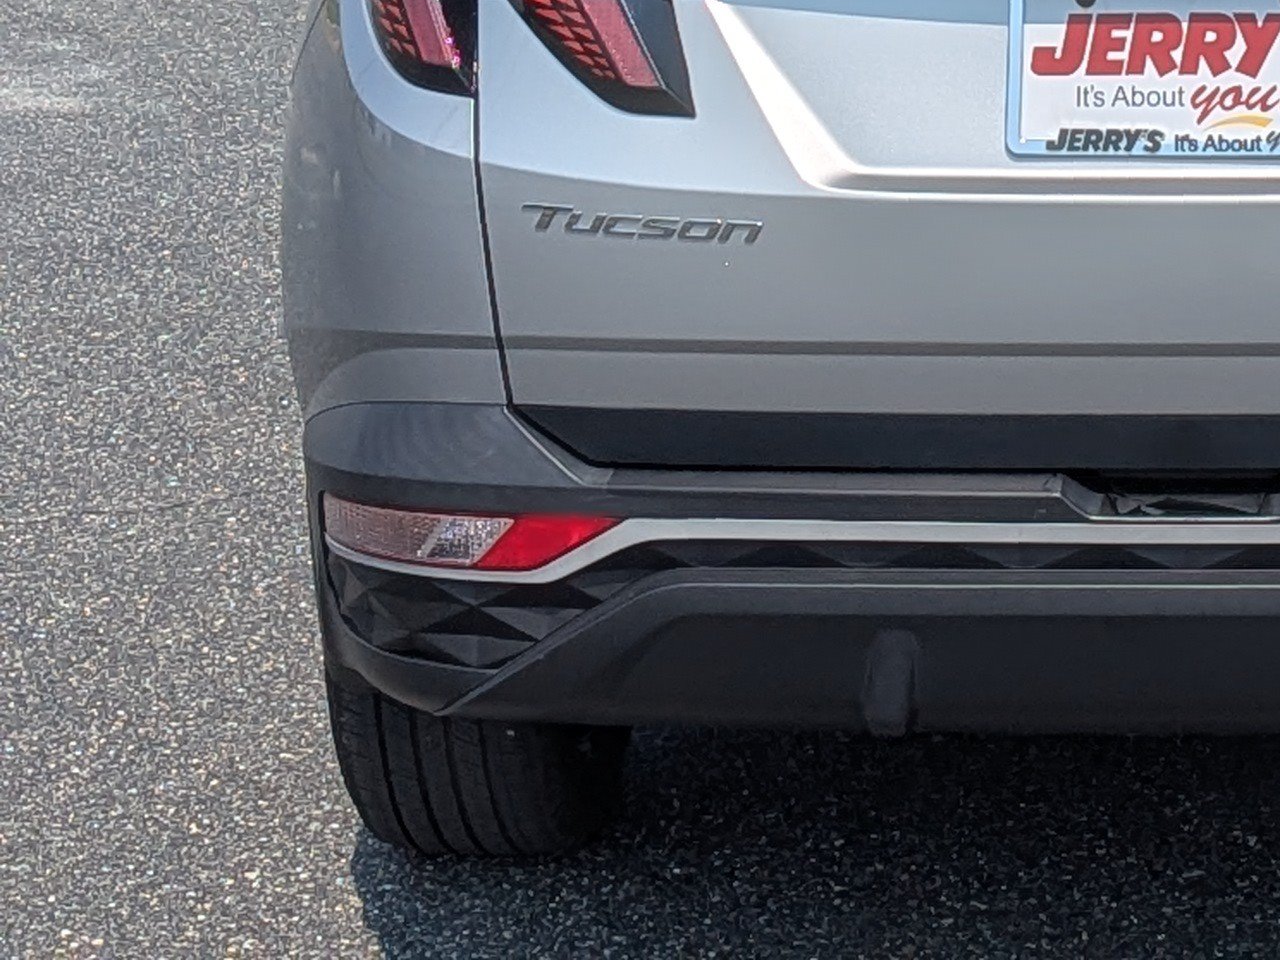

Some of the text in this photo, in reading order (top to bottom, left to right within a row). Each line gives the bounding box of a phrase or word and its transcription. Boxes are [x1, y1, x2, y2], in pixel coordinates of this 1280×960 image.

[1075, 86, 1106, 107] It's
[1111, 86, 1185, 107] About
[1045, 128, 1164, 152] JERRY'S
[1174, 134, 1198, 152] It's
[1202, 133, 1262, 152] About
